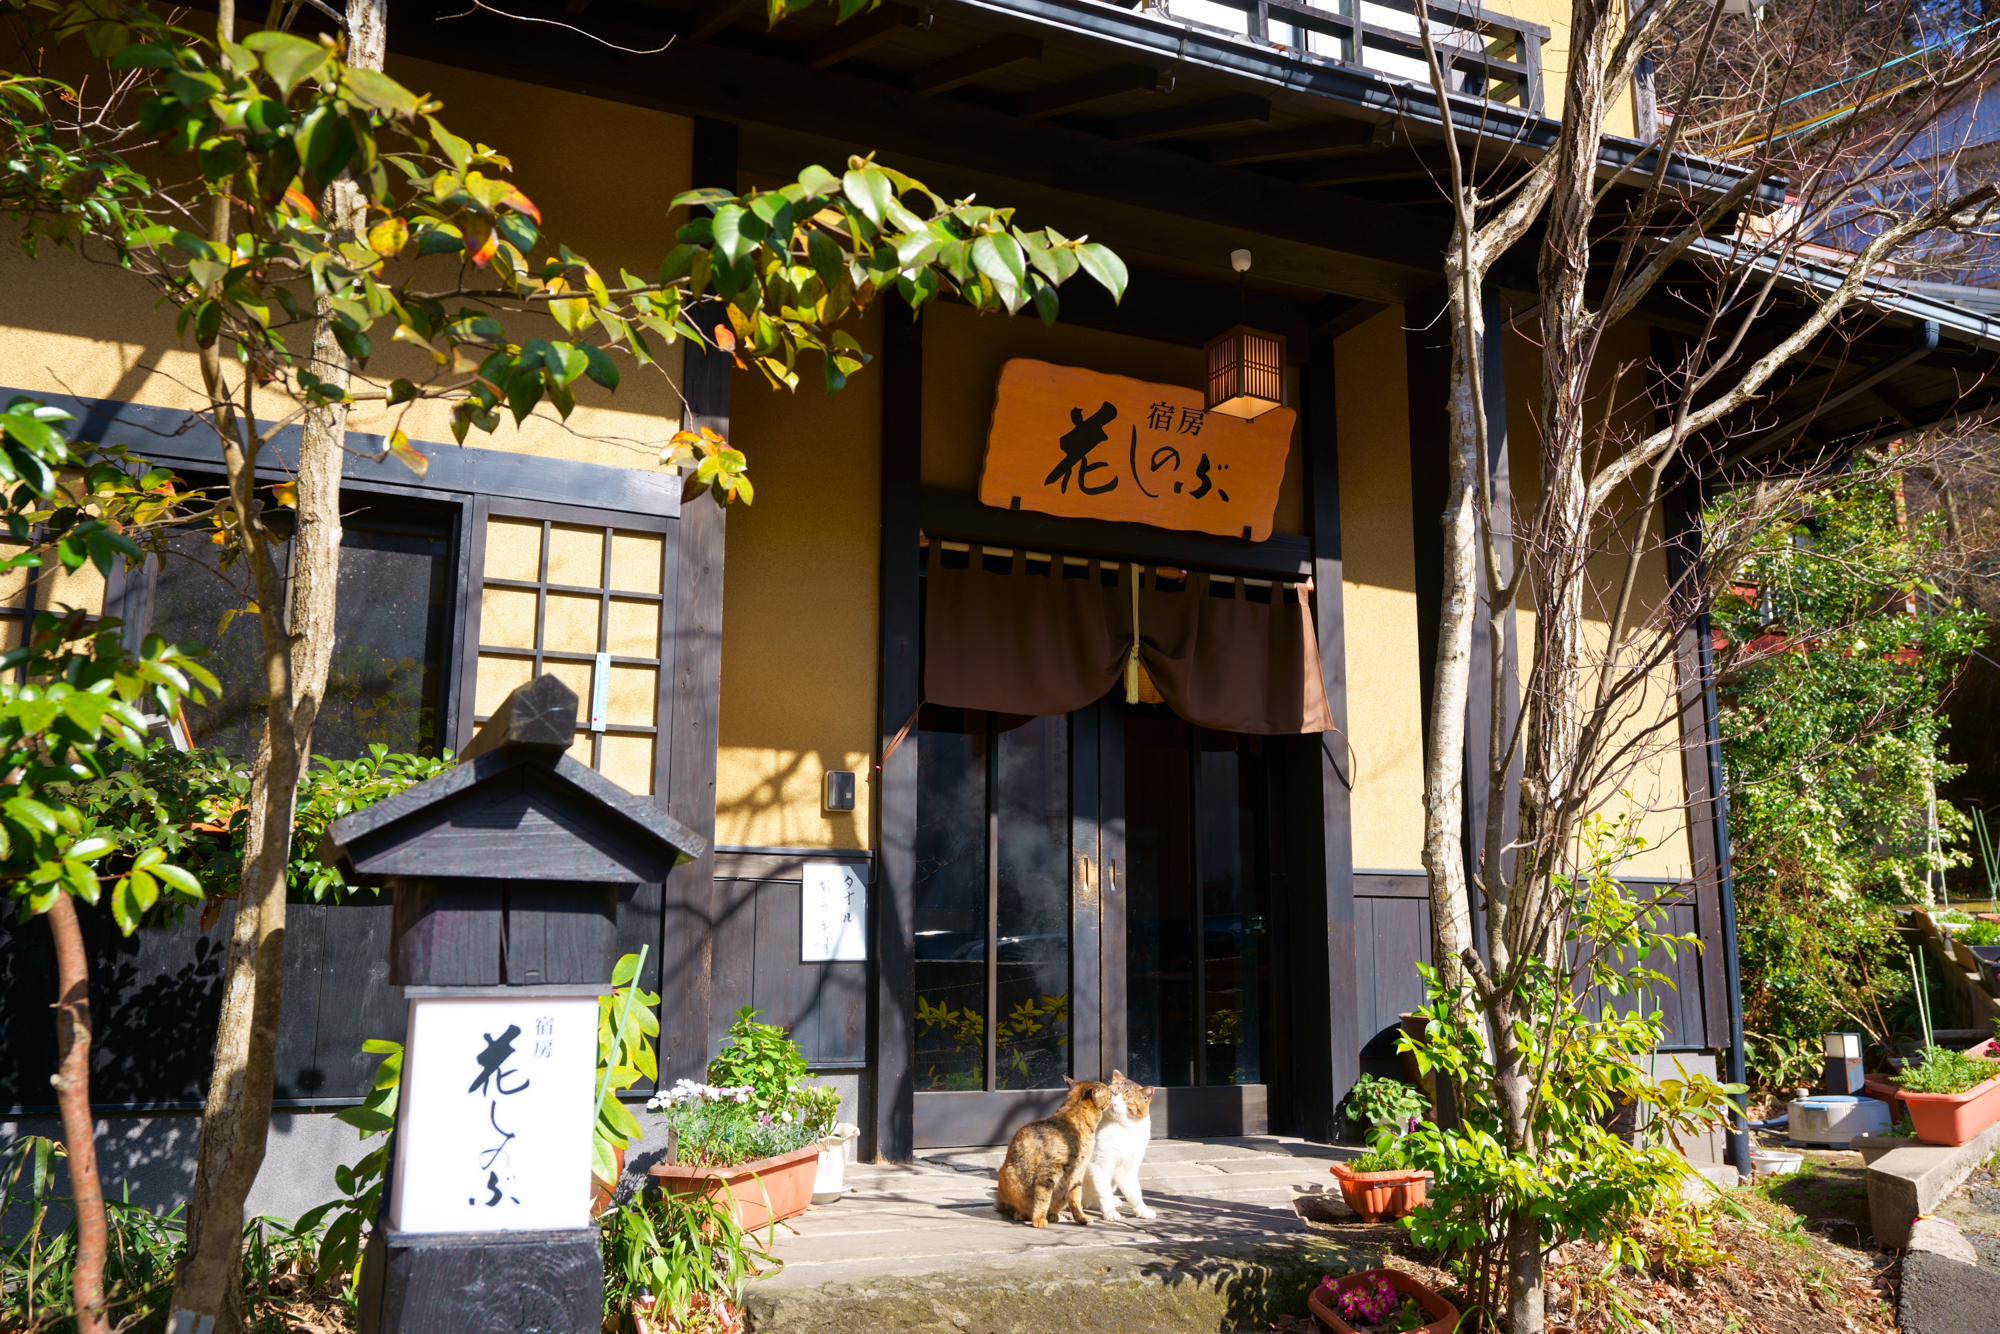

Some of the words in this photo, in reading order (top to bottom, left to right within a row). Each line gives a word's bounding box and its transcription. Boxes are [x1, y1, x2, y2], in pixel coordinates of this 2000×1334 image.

[1147, 401, 1205, 436] 宿房
[1044, 401, 1230, 502] 花しのぶ
[842, 874, 856, 924] タオル
[533, 1016, 555, 1059] 宿房
[468, 1024, 530, 1207] 花しのぶ
